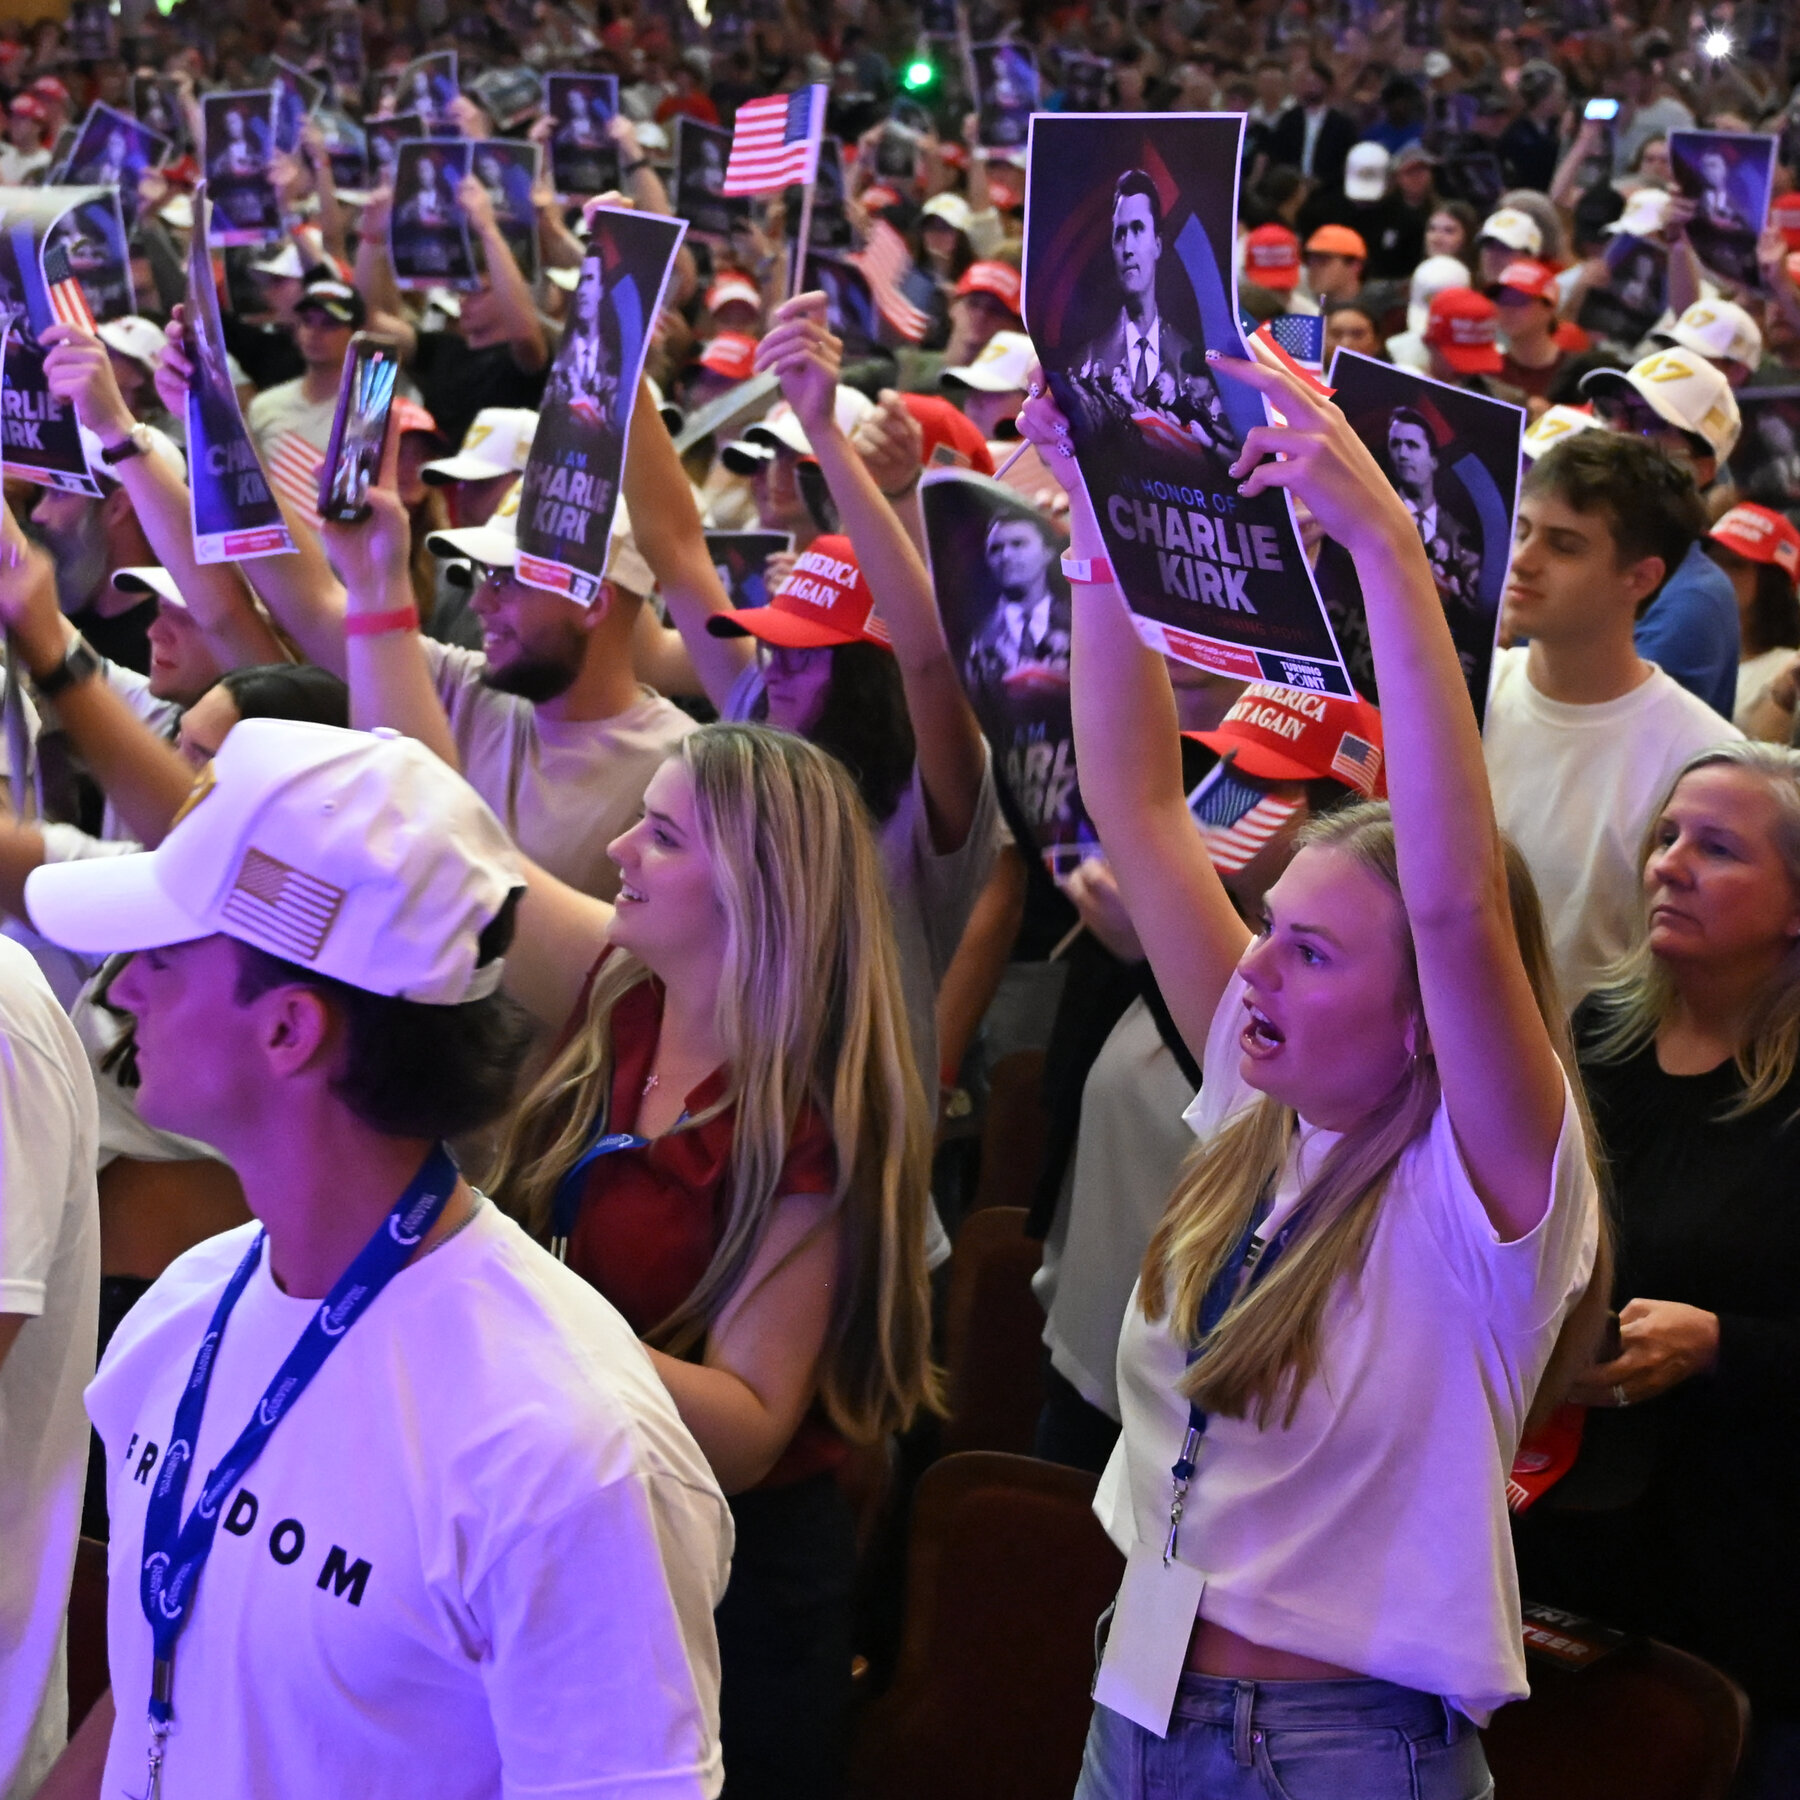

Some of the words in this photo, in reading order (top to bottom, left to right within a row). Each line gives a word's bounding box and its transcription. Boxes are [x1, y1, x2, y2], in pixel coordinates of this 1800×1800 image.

[1141, 478, 1208, 509] HONOR
[531, 497, 591, 545] KIRK
[1107, 494, 1285, 572] CHARLIE
[1157, 550, 1259, 616] KIRK
[1280, 660, 1322, 677] TURNING
[1285, 671, 1326, 691] POINT
[1244, 703, 1307, 742] AGAIN
